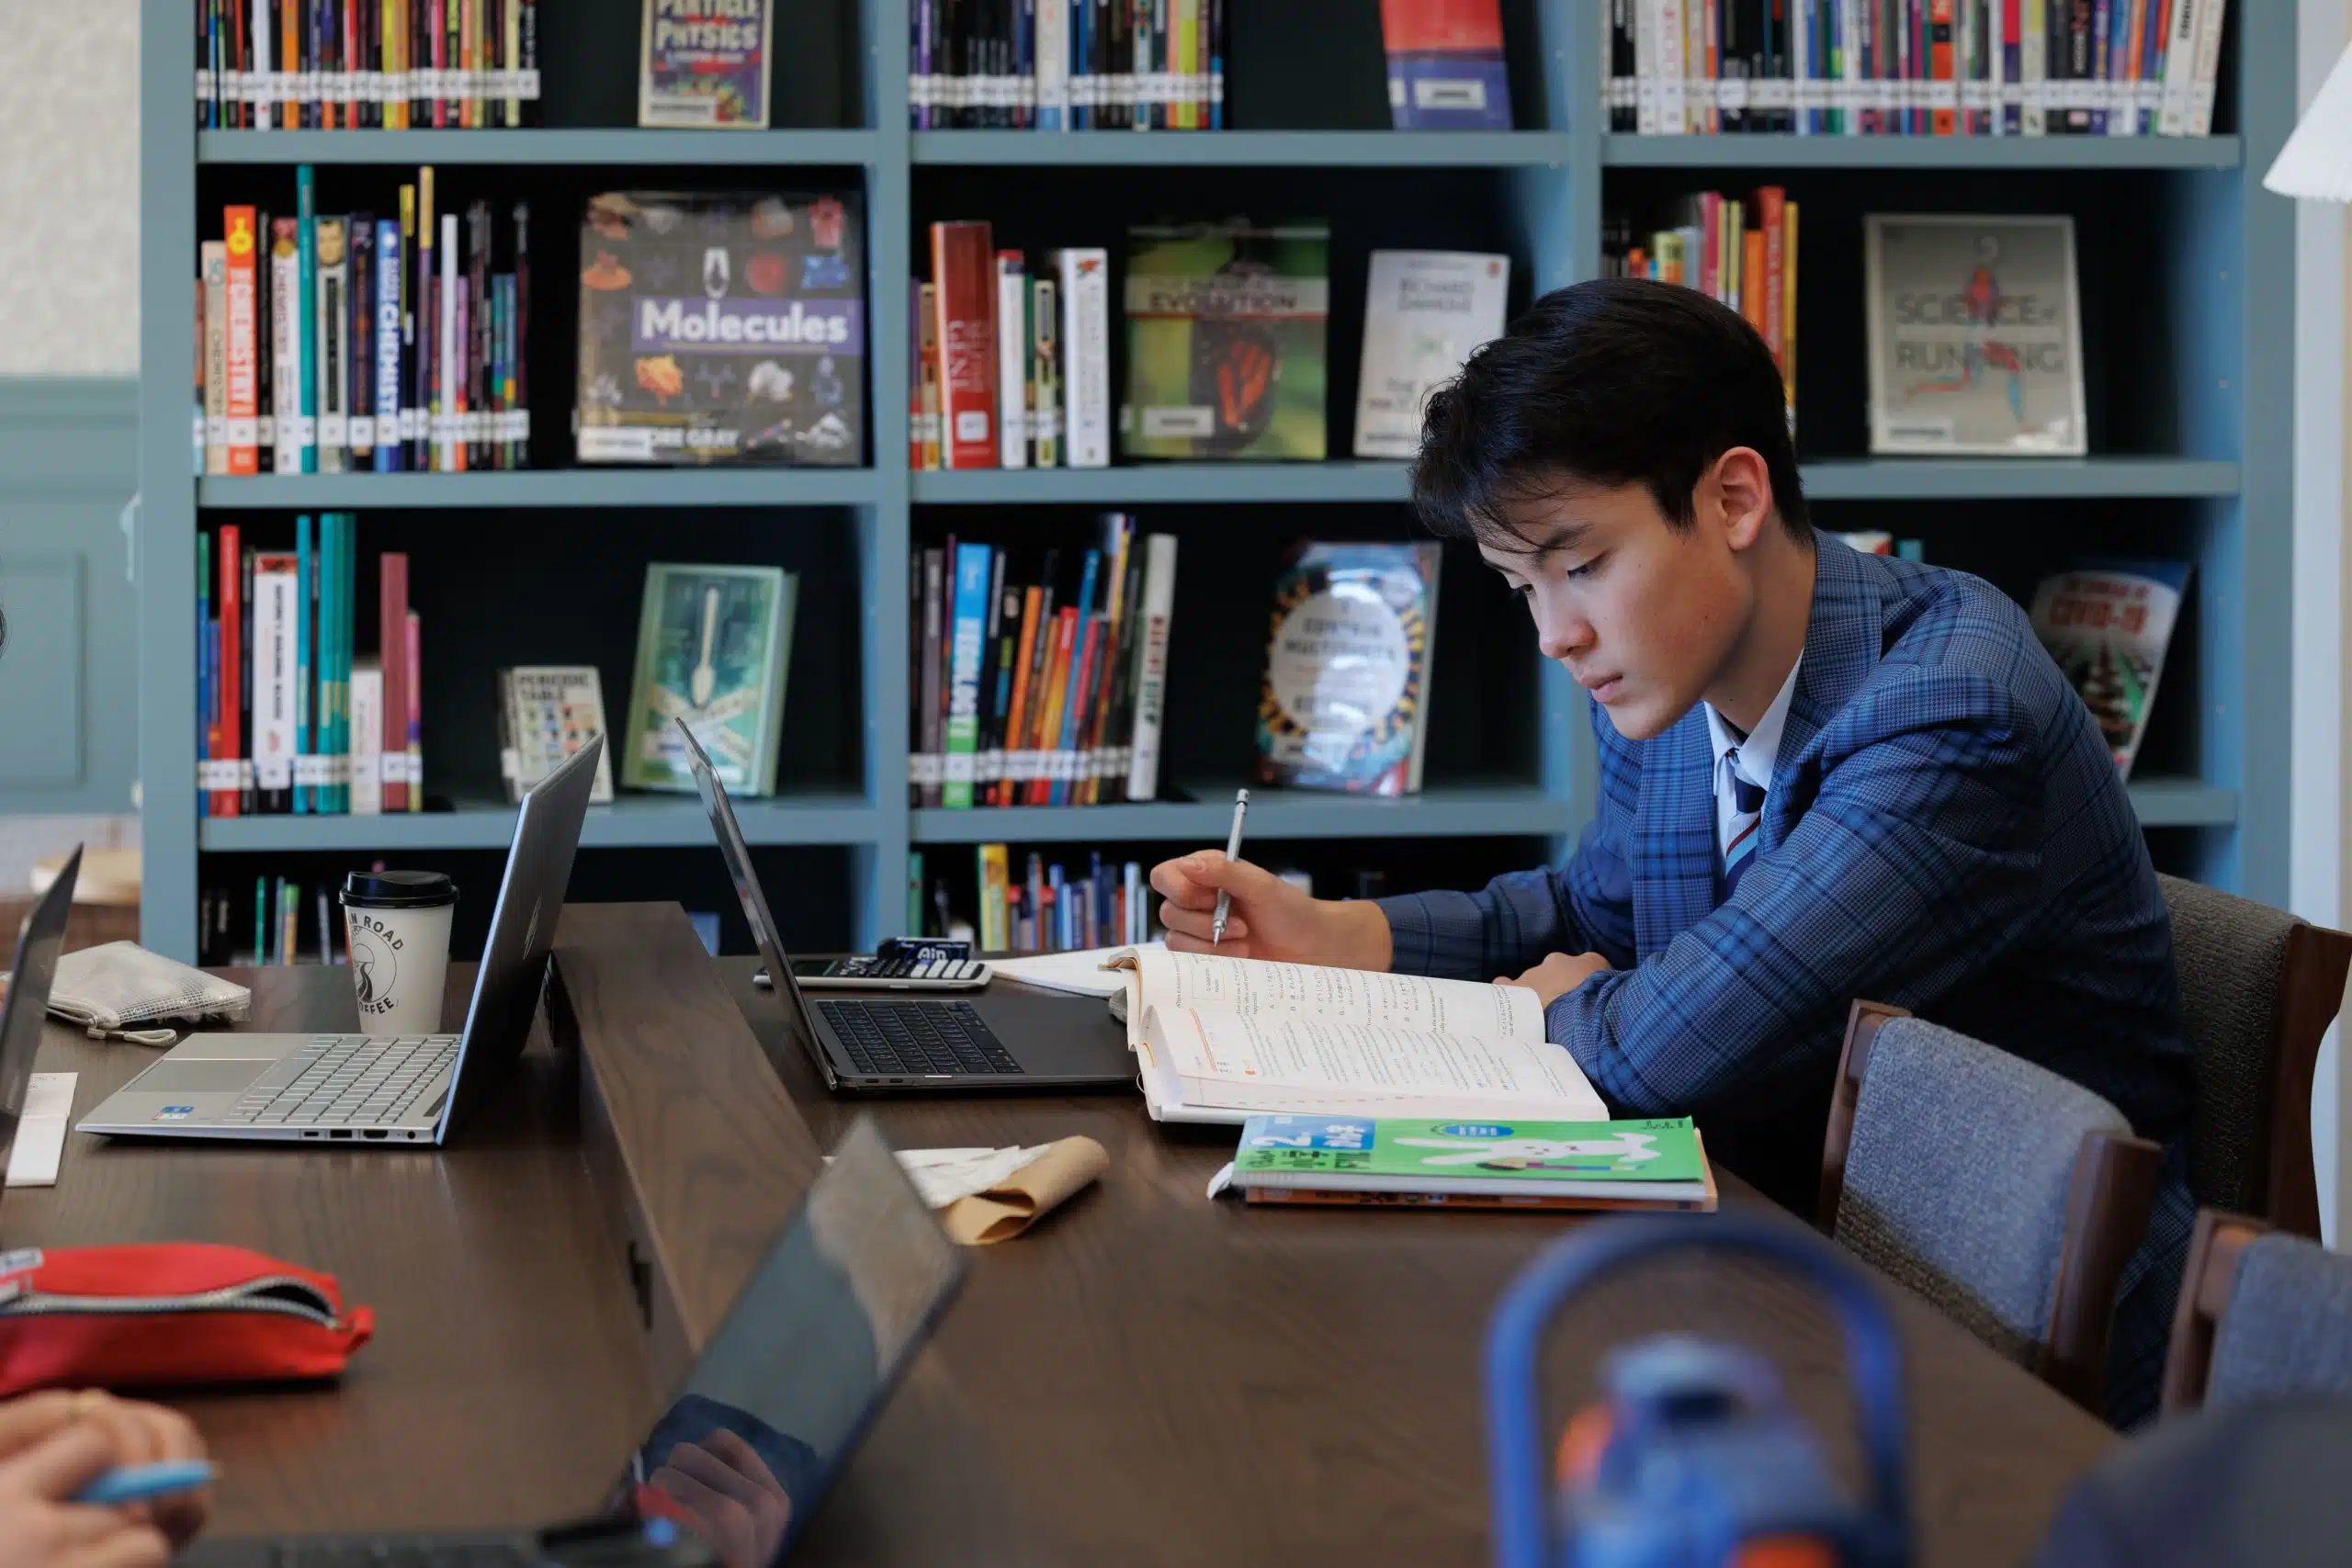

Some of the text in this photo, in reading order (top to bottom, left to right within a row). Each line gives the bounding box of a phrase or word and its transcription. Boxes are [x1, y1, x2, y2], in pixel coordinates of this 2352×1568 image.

[640, 299, 849, 344] Molecules
[1895, 294, 2035, 323] SCIECE
[379, 301, 399, 416] CHEMIST
[364, 915, 404, 950] ROAD
[917, 947, 946, 961] Ain
[359, 998, 394, 1015] OFFEE
